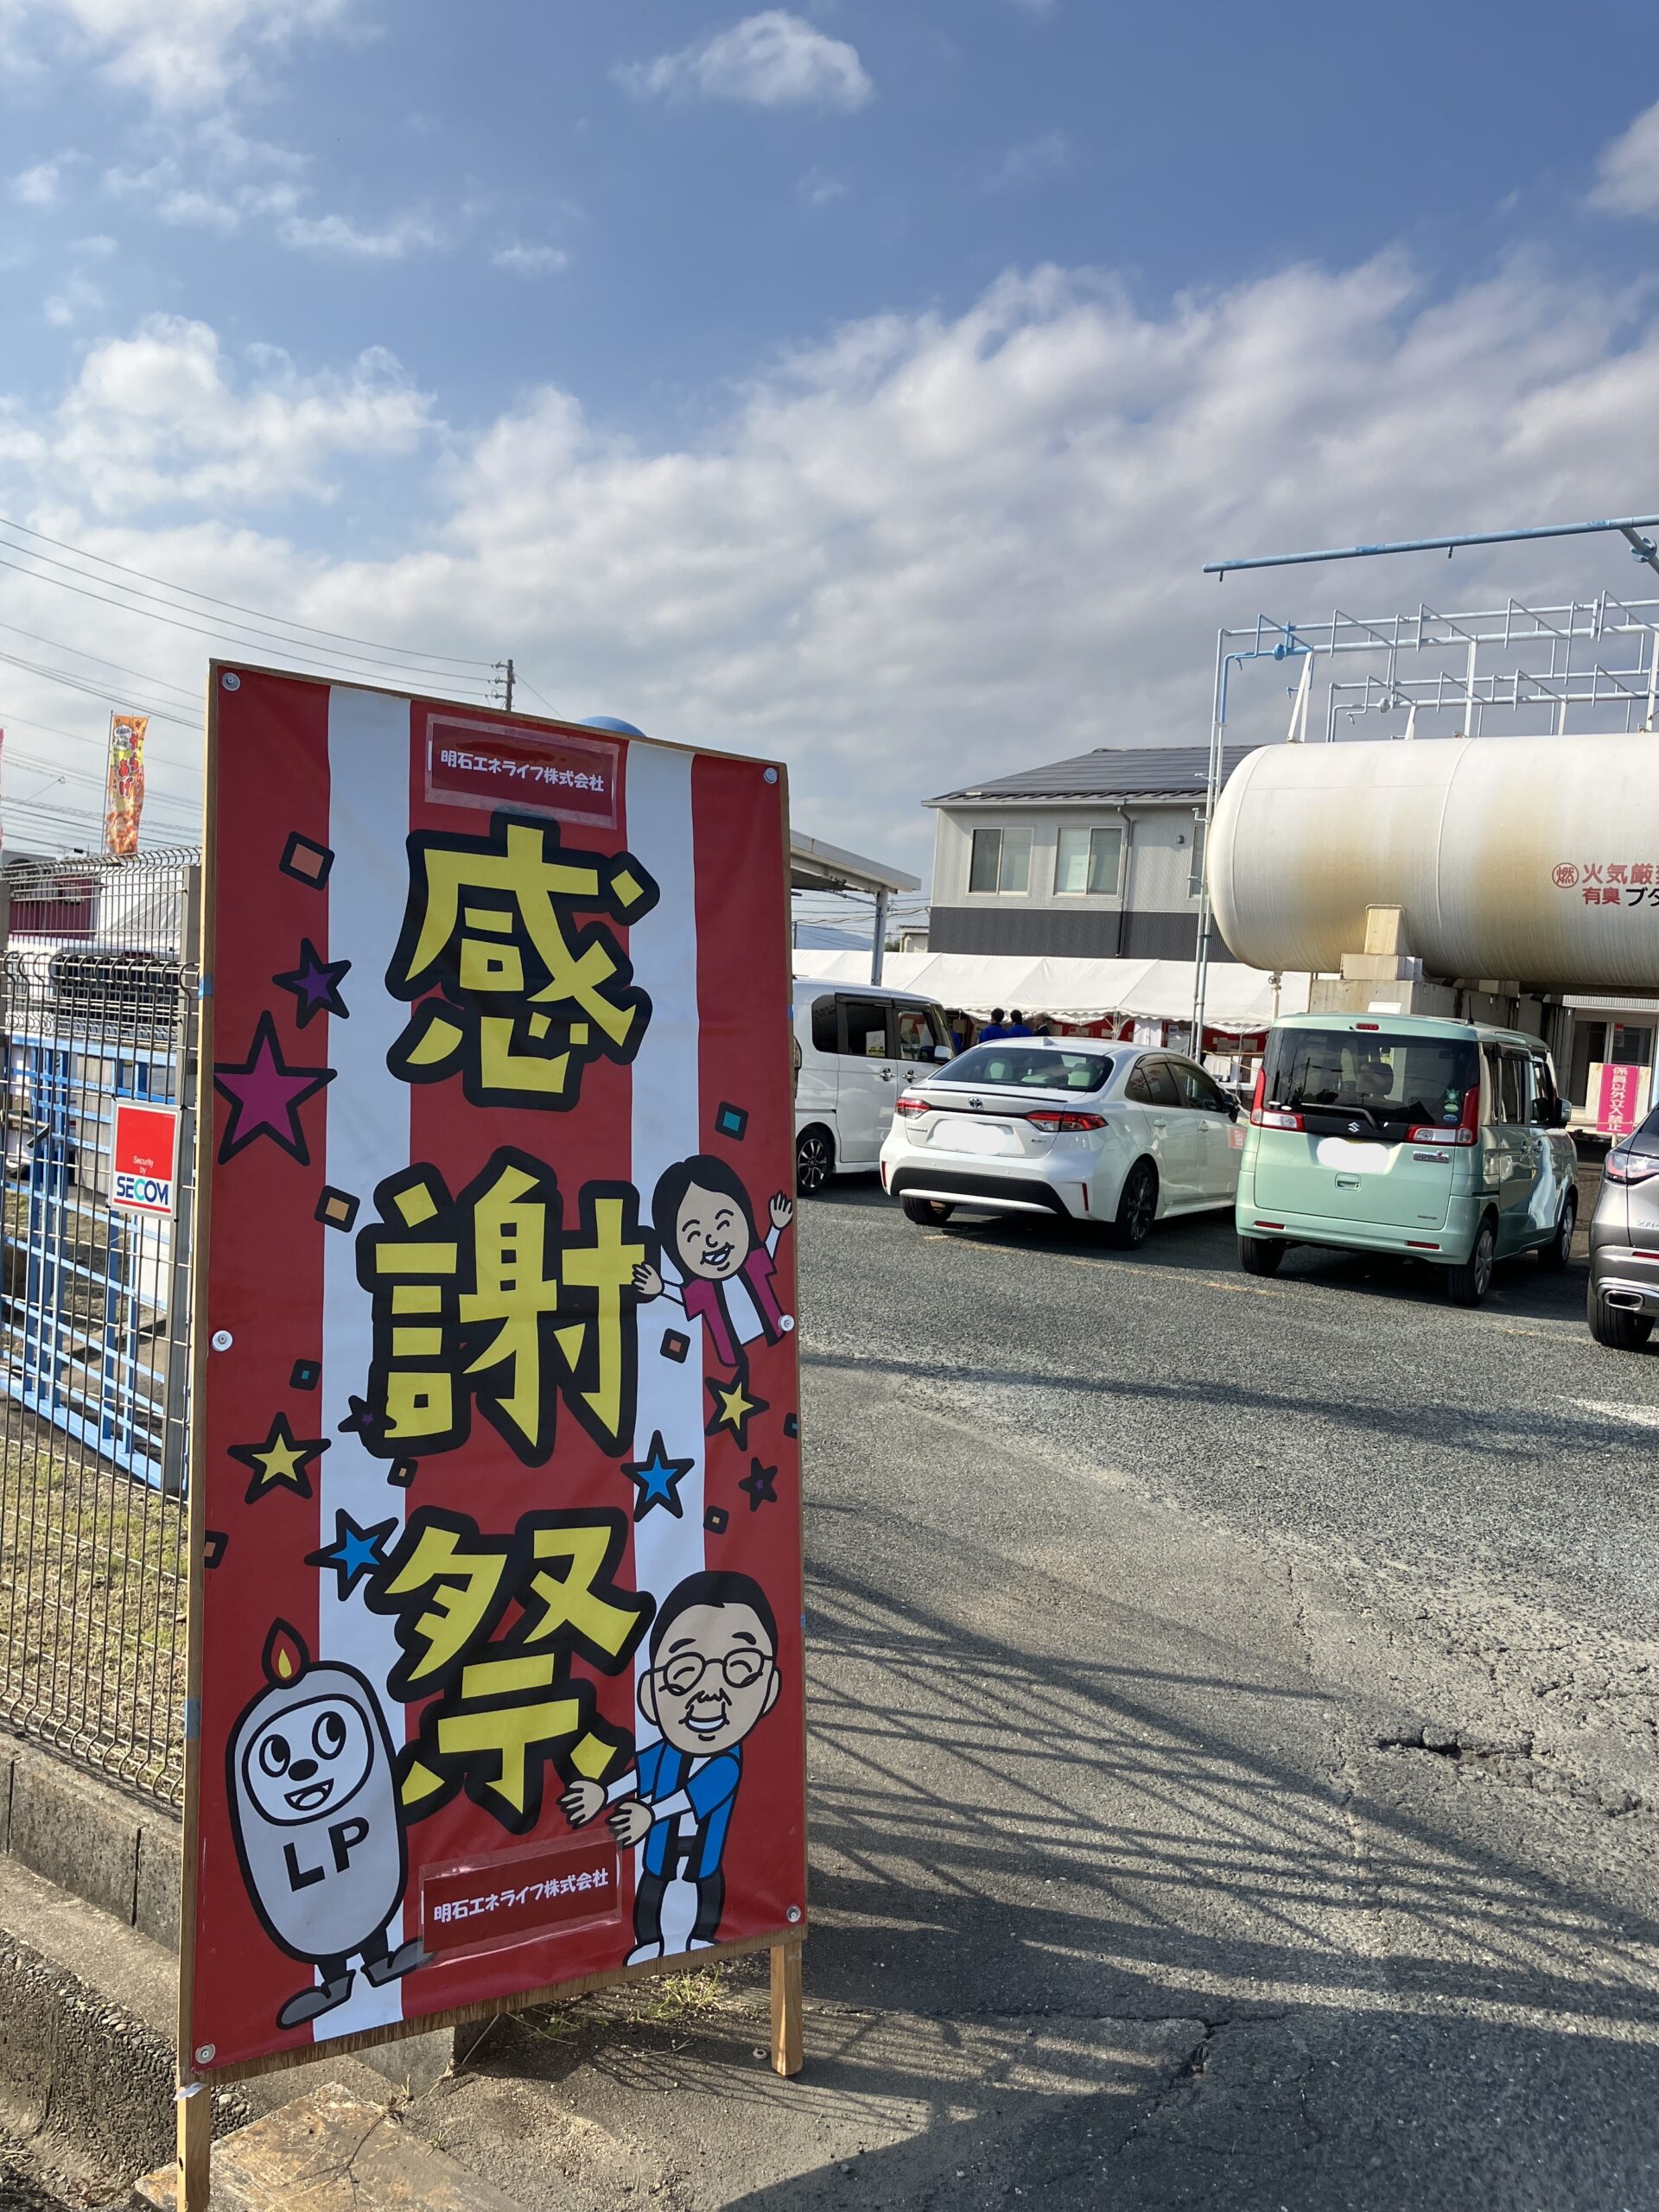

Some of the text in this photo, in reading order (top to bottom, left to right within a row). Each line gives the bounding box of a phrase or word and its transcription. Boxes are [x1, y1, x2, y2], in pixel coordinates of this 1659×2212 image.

[441, 749, 605, 792] 明石エネライフ株式会社
[1582, 862, 1659, 885] 火気厳
[1607, 1066, 1629, 1132] 係員以外立入禁止
[132, 1155, 154, 1167] Security
[139, 1166, 147, 1175] by
[117, 1176, 168, 1205] SECOM
[372, 819, 651, 1821] 感謝祭
[283, 1816, 370, 1892] LP
[434, 1867, 609, 1923] 明石エネライフ株式会社
